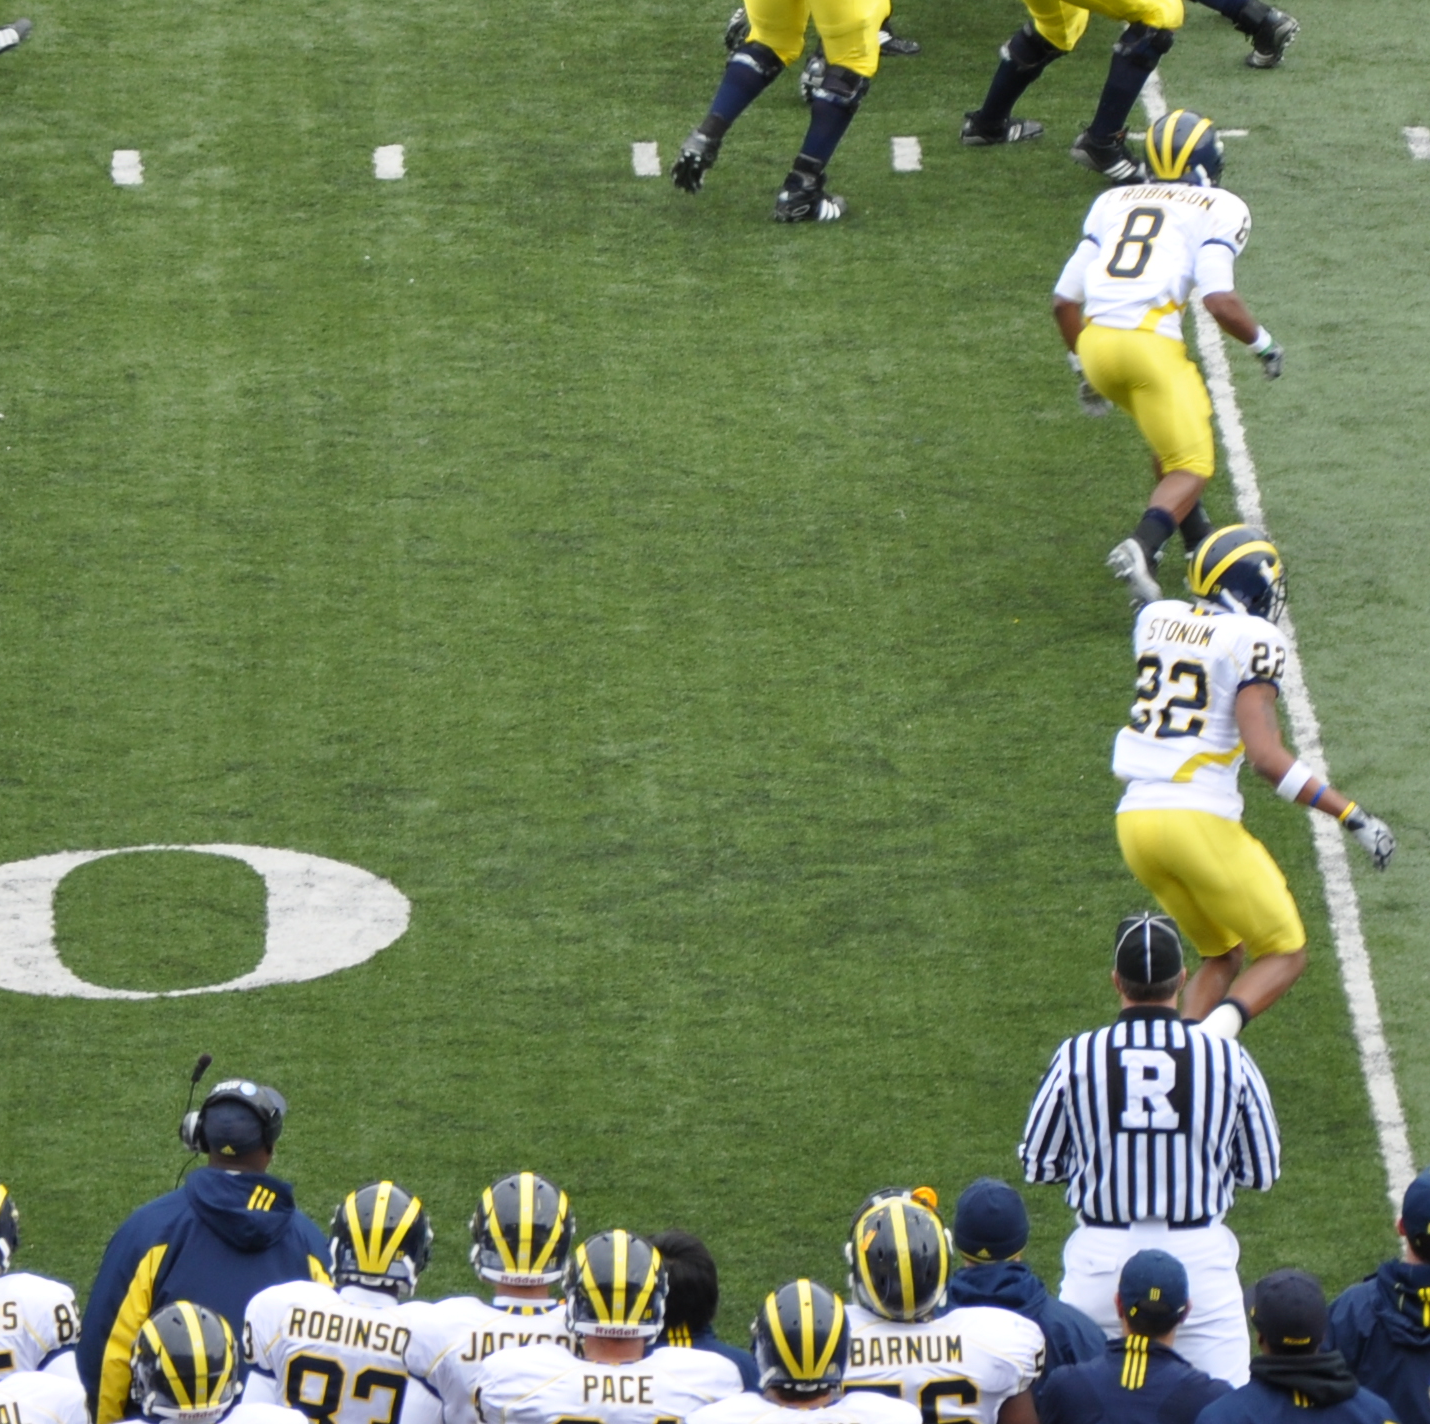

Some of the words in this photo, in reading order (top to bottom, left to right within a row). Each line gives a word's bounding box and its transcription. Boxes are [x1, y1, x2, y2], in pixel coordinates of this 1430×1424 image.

[1120, 186, 1217, 211] ROBINSON
[1106, 206, 1165, 279] 8
[1146, 617, 1217, 648] STONUM
[1251, 641, 1287, 680] 22
[1120, 1049, 1179, 1129] R
[500, 1275, 545, 1286] Riddell
[595, 1327, 639, 1337] Riddell
[850, 1335, 963, 1367] BARNUM
[582, 1375, 654, 1405] PACE
